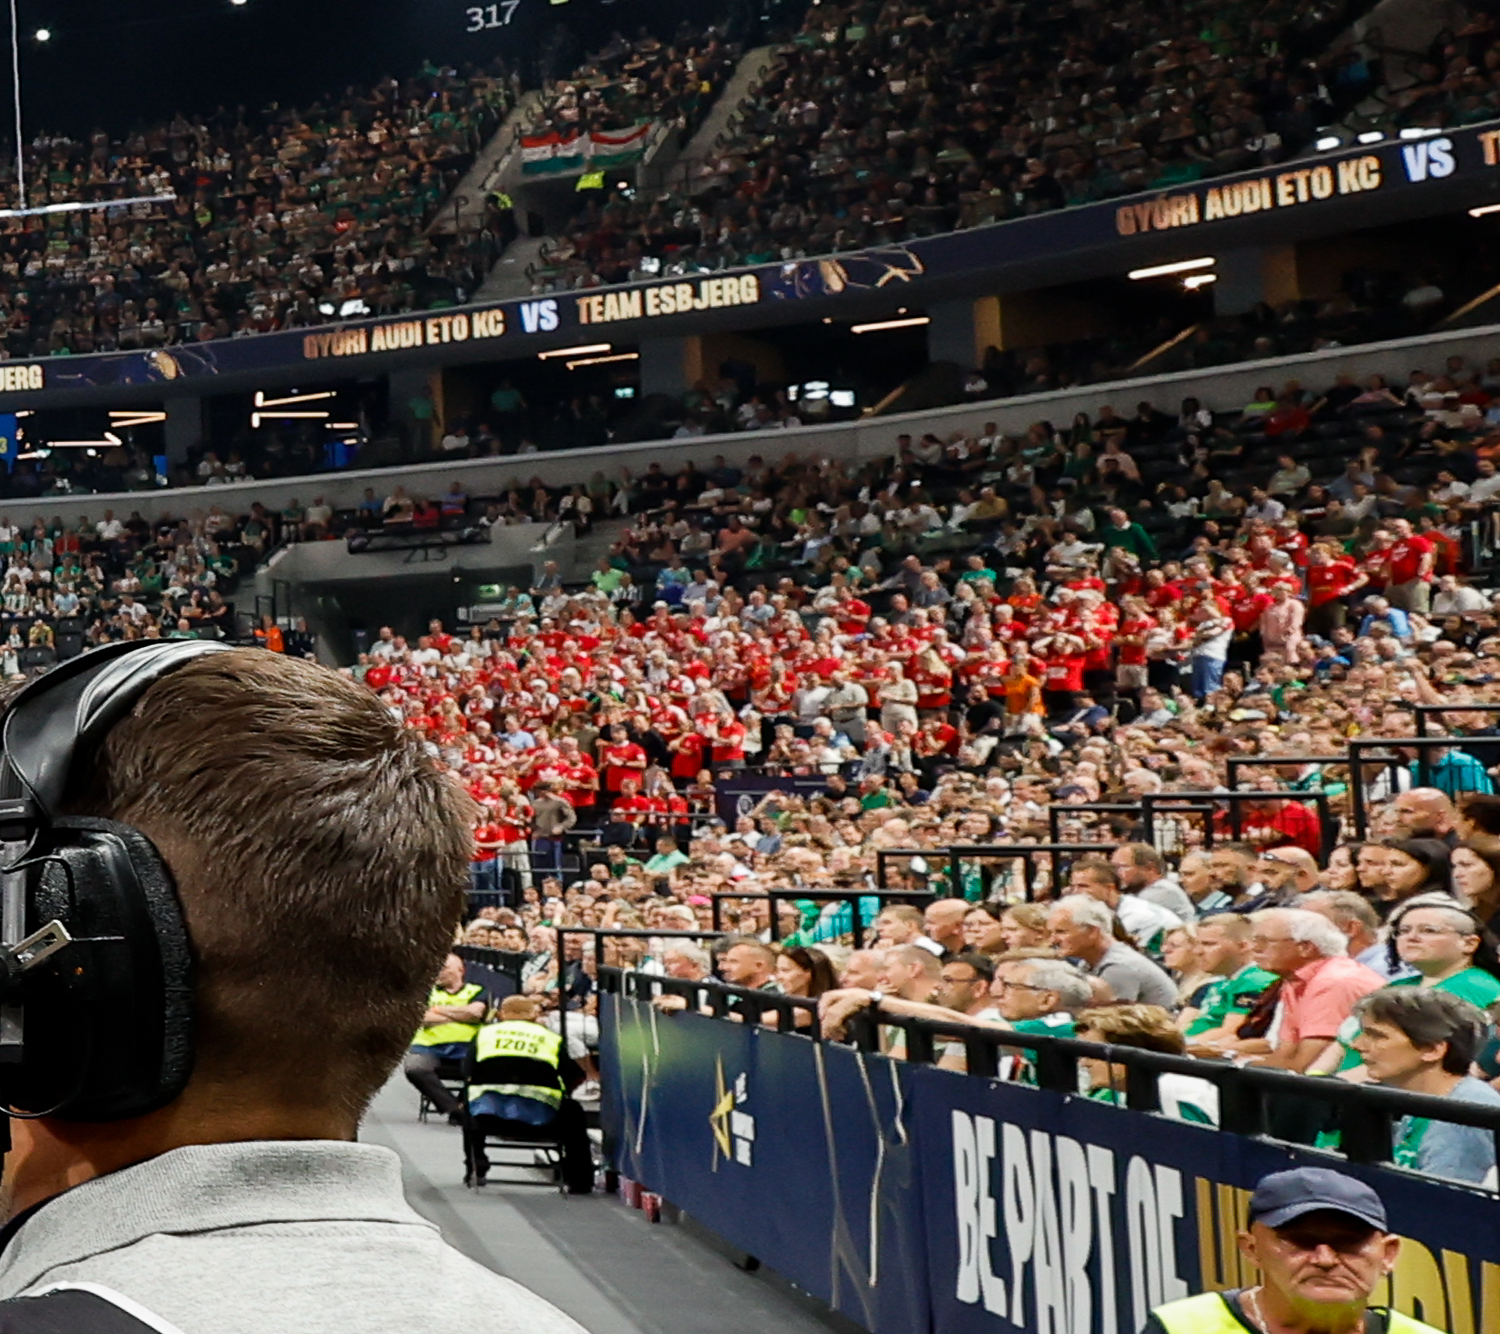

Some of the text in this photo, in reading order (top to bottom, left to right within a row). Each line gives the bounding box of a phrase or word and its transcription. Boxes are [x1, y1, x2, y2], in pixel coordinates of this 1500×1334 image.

[1204, 137, 1455, 221] AUDI ETO KC VS
[372, 274, 759, 352] AUDI ETO KC VS TEAM ESBJERG
[495, 1038, 539, 1055] 1205
[951, 1108, 1006, 1318] BE
